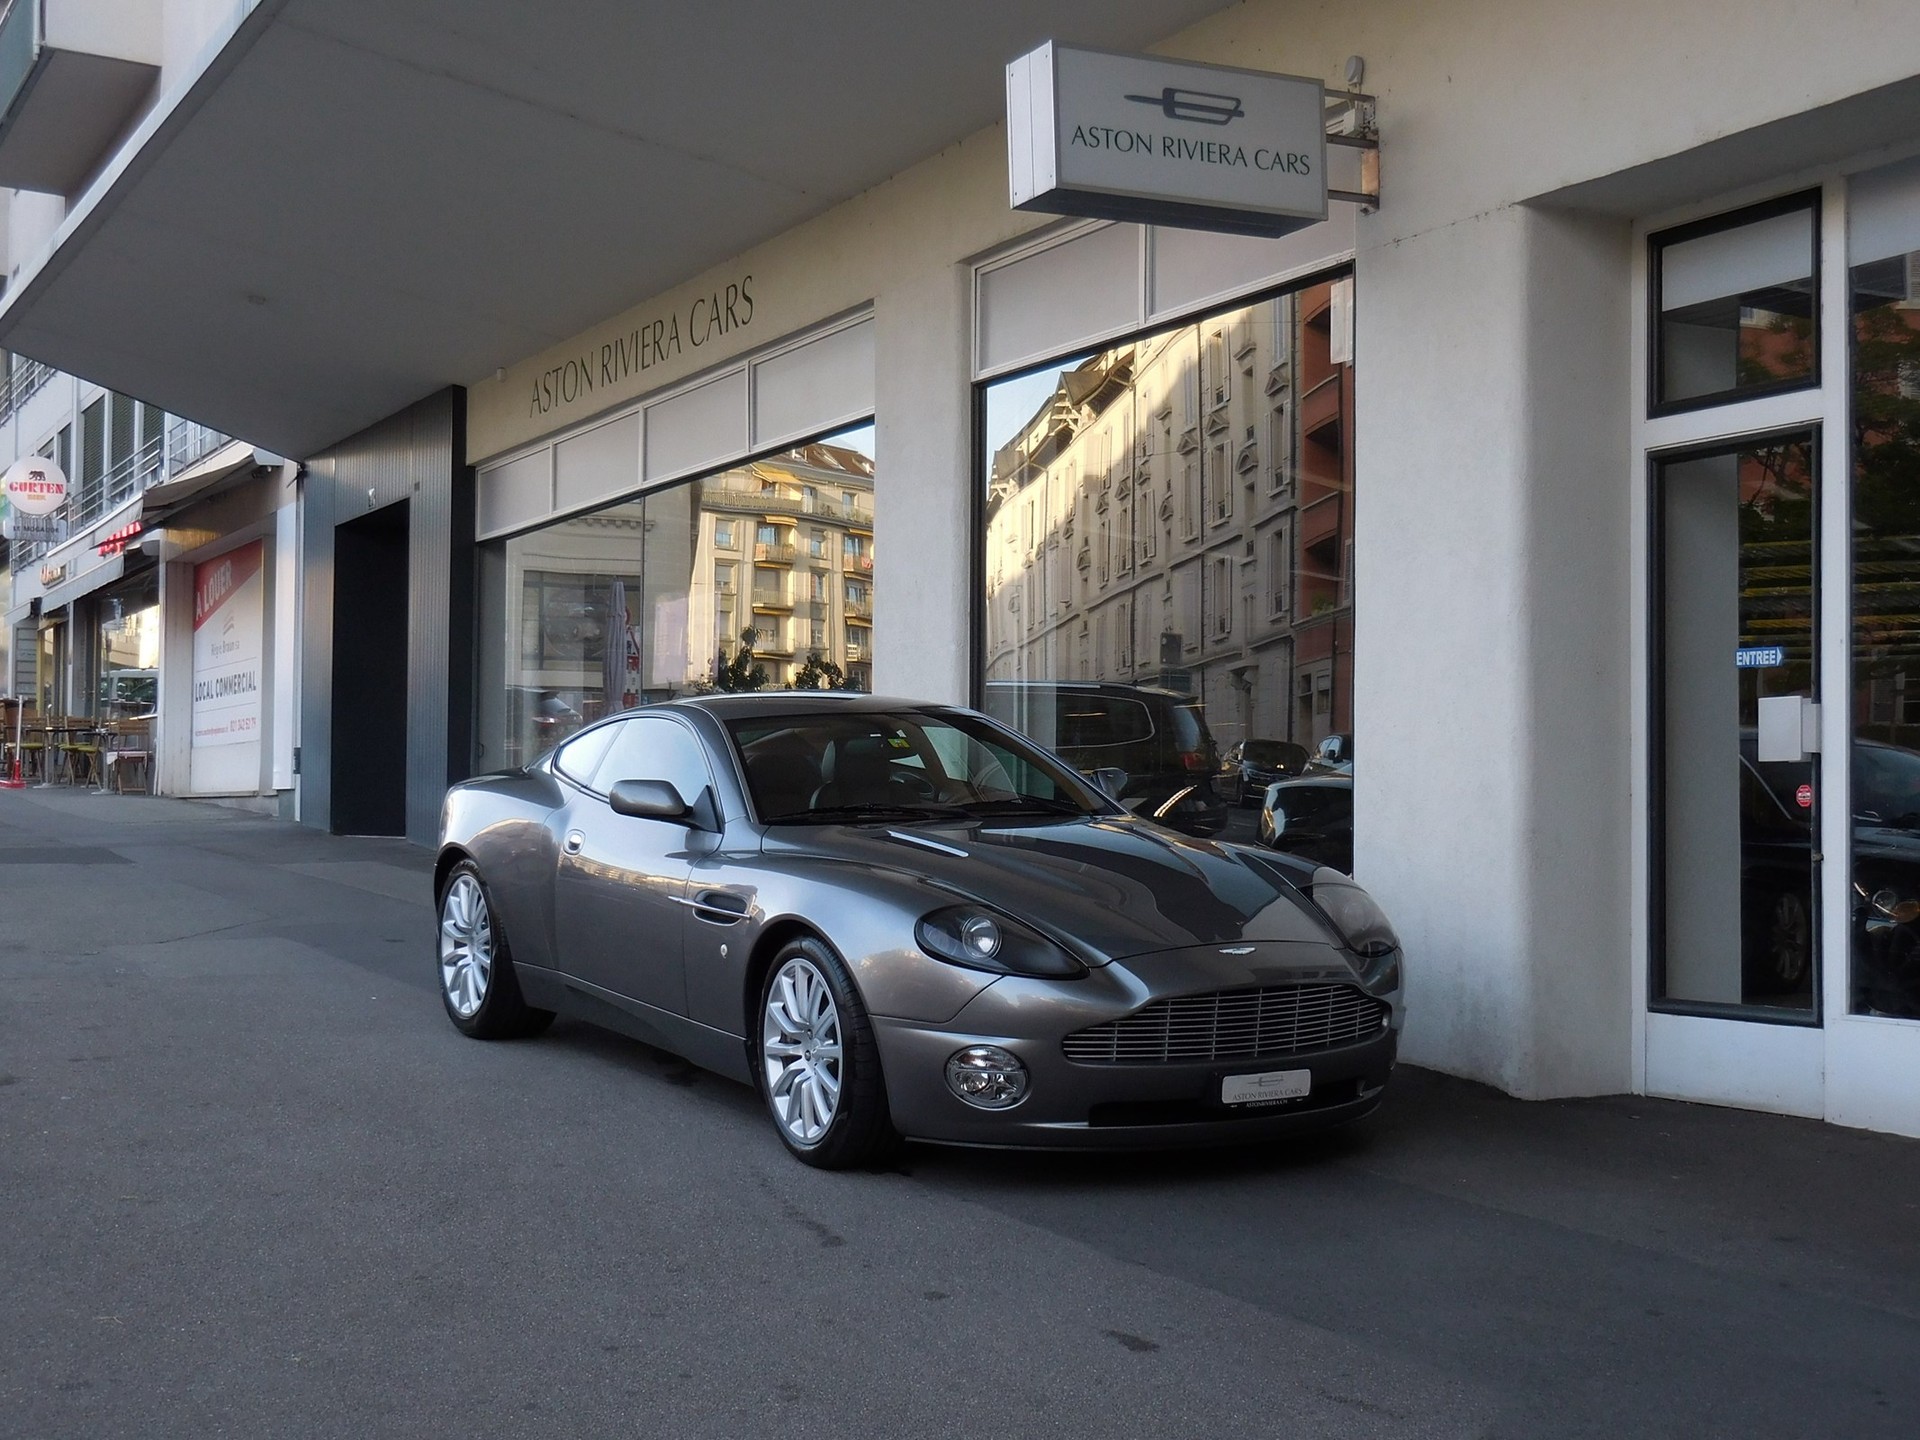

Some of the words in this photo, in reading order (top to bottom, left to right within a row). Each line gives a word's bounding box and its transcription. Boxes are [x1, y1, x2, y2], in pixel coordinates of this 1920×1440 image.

[1071, 125, 1152, 155] ASTON
[1162, 136, 1248, 168] RIVIERA
[1254, 149, 1311, 176] CARS
[529, 351, 594, 418] ASTON
[601, 312, 682, 388] RIVIERA
[689, 275, 754, 347] CARS
[9, 481, 64, 494] GURTEN
[204, 559, 232, 613] LOUER
[1735, 649, 1777, 666] ENTREE
[195, 680, 214, 702] LOCAL
[216, 671, 257, 698] COMMERCIAL
[1232, 1092, 1256, 1101] ASTON
[1257, 1089, 1283, 1099] RIVIERA
[1284, 1088, 1303, 1096] CARS
